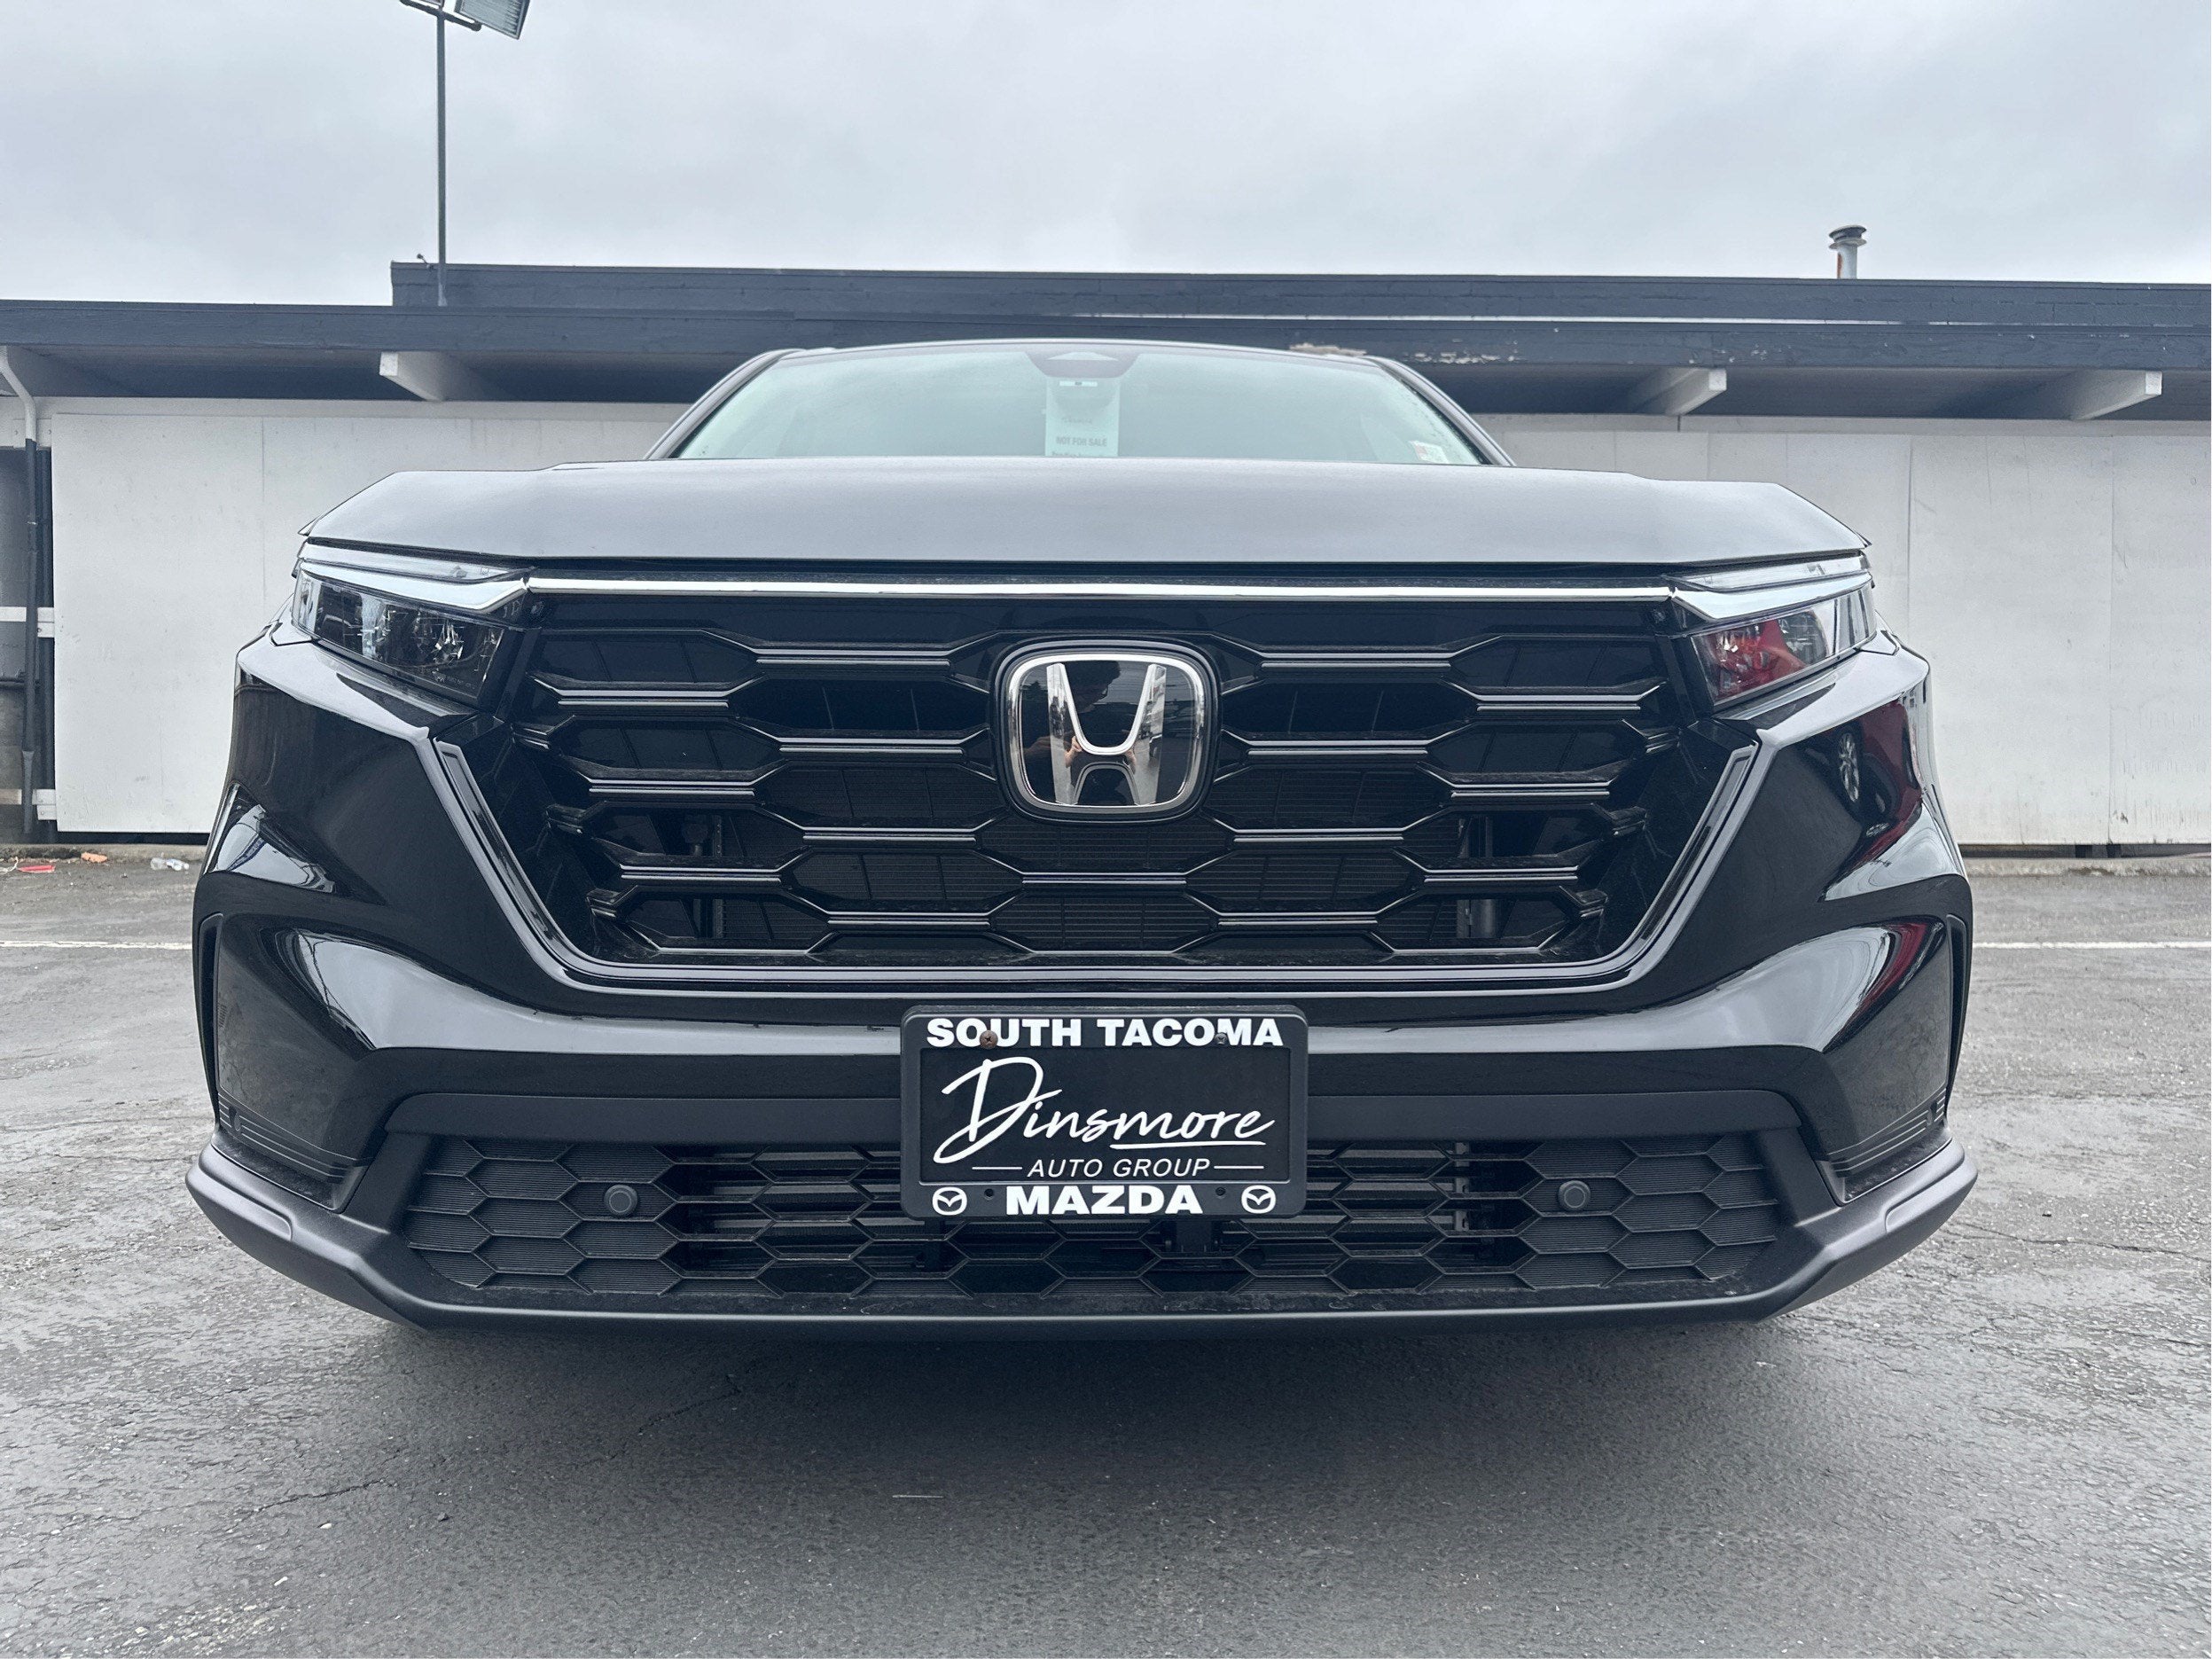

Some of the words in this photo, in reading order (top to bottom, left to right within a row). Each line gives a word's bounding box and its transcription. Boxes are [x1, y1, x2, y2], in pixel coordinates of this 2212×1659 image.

[1088, 438, 1107, 448] SALE
[926, 1018, 1082, 1047] SOUTH
[1097, 1018, 1284, 1047] TACOMA
[933, 1056, 1276, 1163] Dinsmore
[1027, 1158, 1103, 1178] AUTO
[1113, 1158, 1210, 1178] GROUP
[1005, 1184, 1204, 1216] MAZDA
